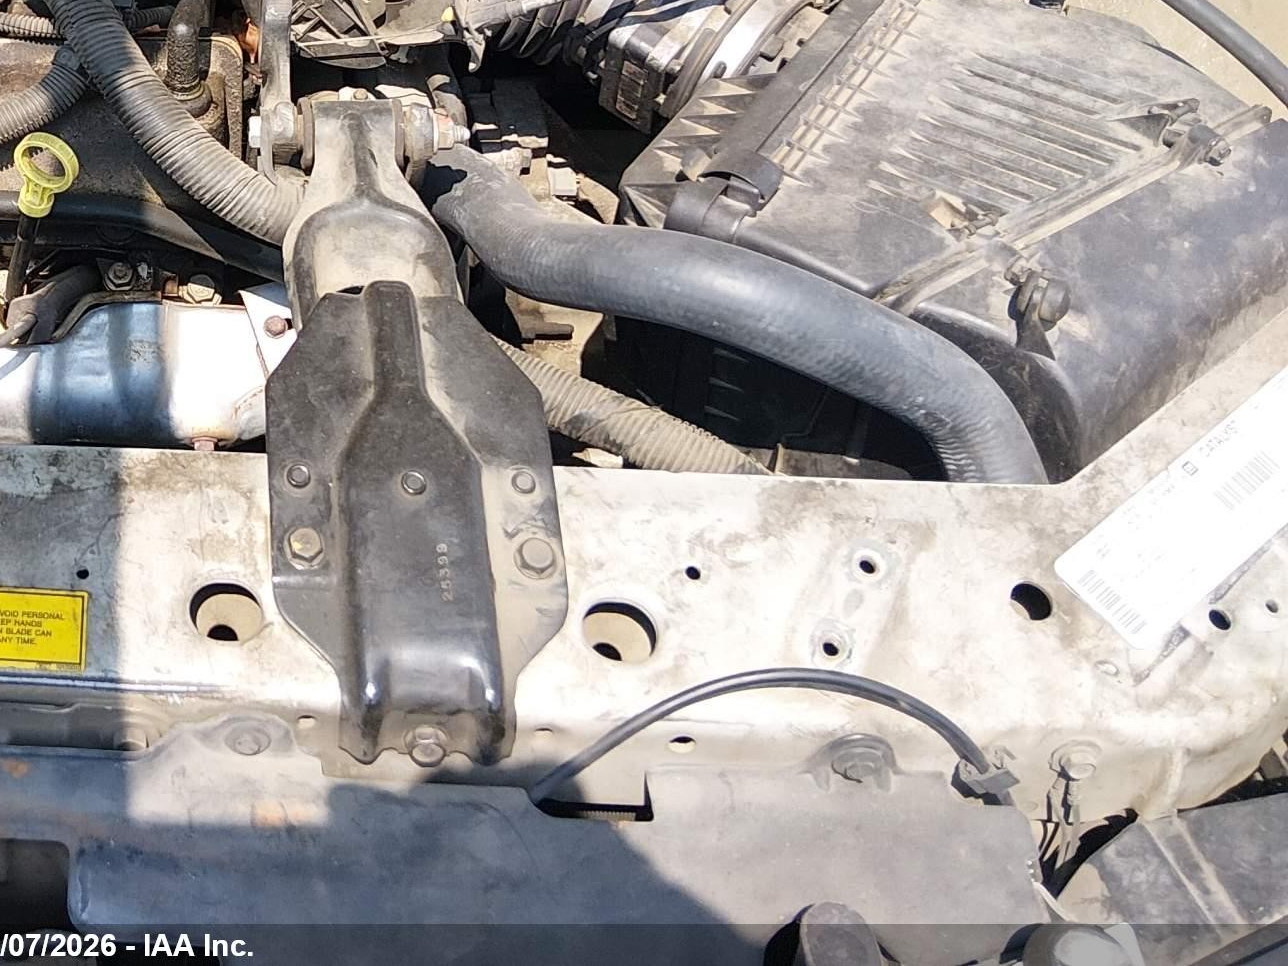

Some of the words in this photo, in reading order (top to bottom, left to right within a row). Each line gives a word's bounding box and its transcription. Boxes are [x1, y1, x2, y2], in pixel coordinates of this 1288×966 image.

[21, 611, 64, 620] PERSONAL
[14, 619, 43, 628] HANDS
[5, 627, 32, 636] BLADE
[35, 629, 52, 637] CAN
